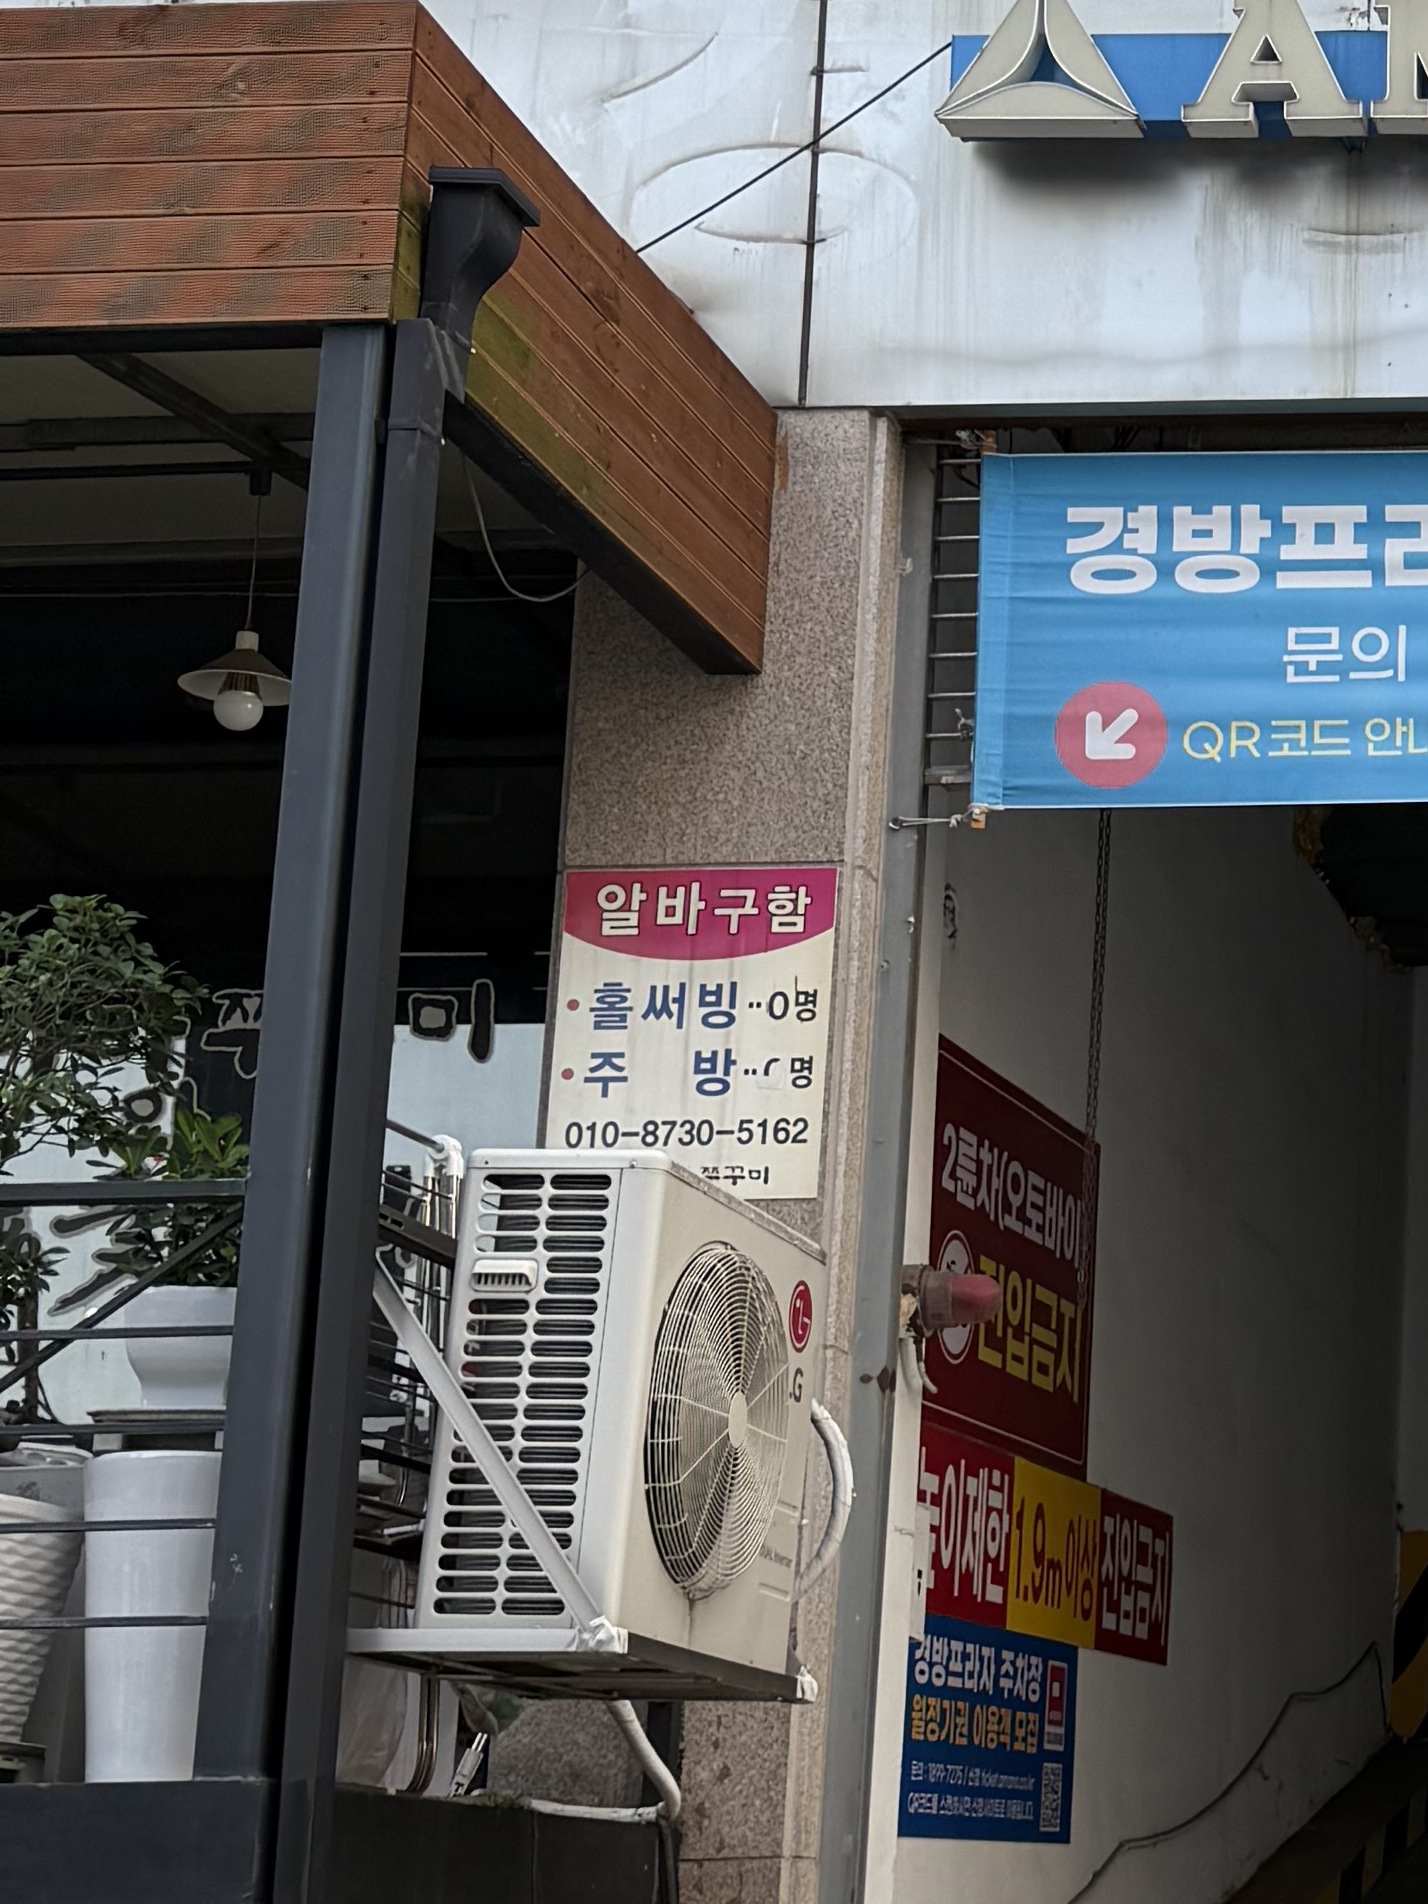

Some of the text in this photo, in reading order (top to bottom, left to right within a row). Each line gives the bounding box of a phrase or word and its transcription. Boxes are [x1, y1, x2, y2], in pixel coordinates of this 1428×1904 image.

[1283, 624, 1407, 684] 문의
[1182, 718, 1352, 762] QR코드
[597, 881, 812, 937] 알바구함
[589, 981, 739, 1031] 홀써빙
[565, 1117, 809, 1149] 010-8730-5162
[941, 1122, 1088, 1269] 2륜차(오토바이
[977, 1254, 1085, 1403] 진입금지
[1101, 1513, 1171, 1647] 진입금지
[914, 1635, 1042, 1703] 경방프라자 주차장
